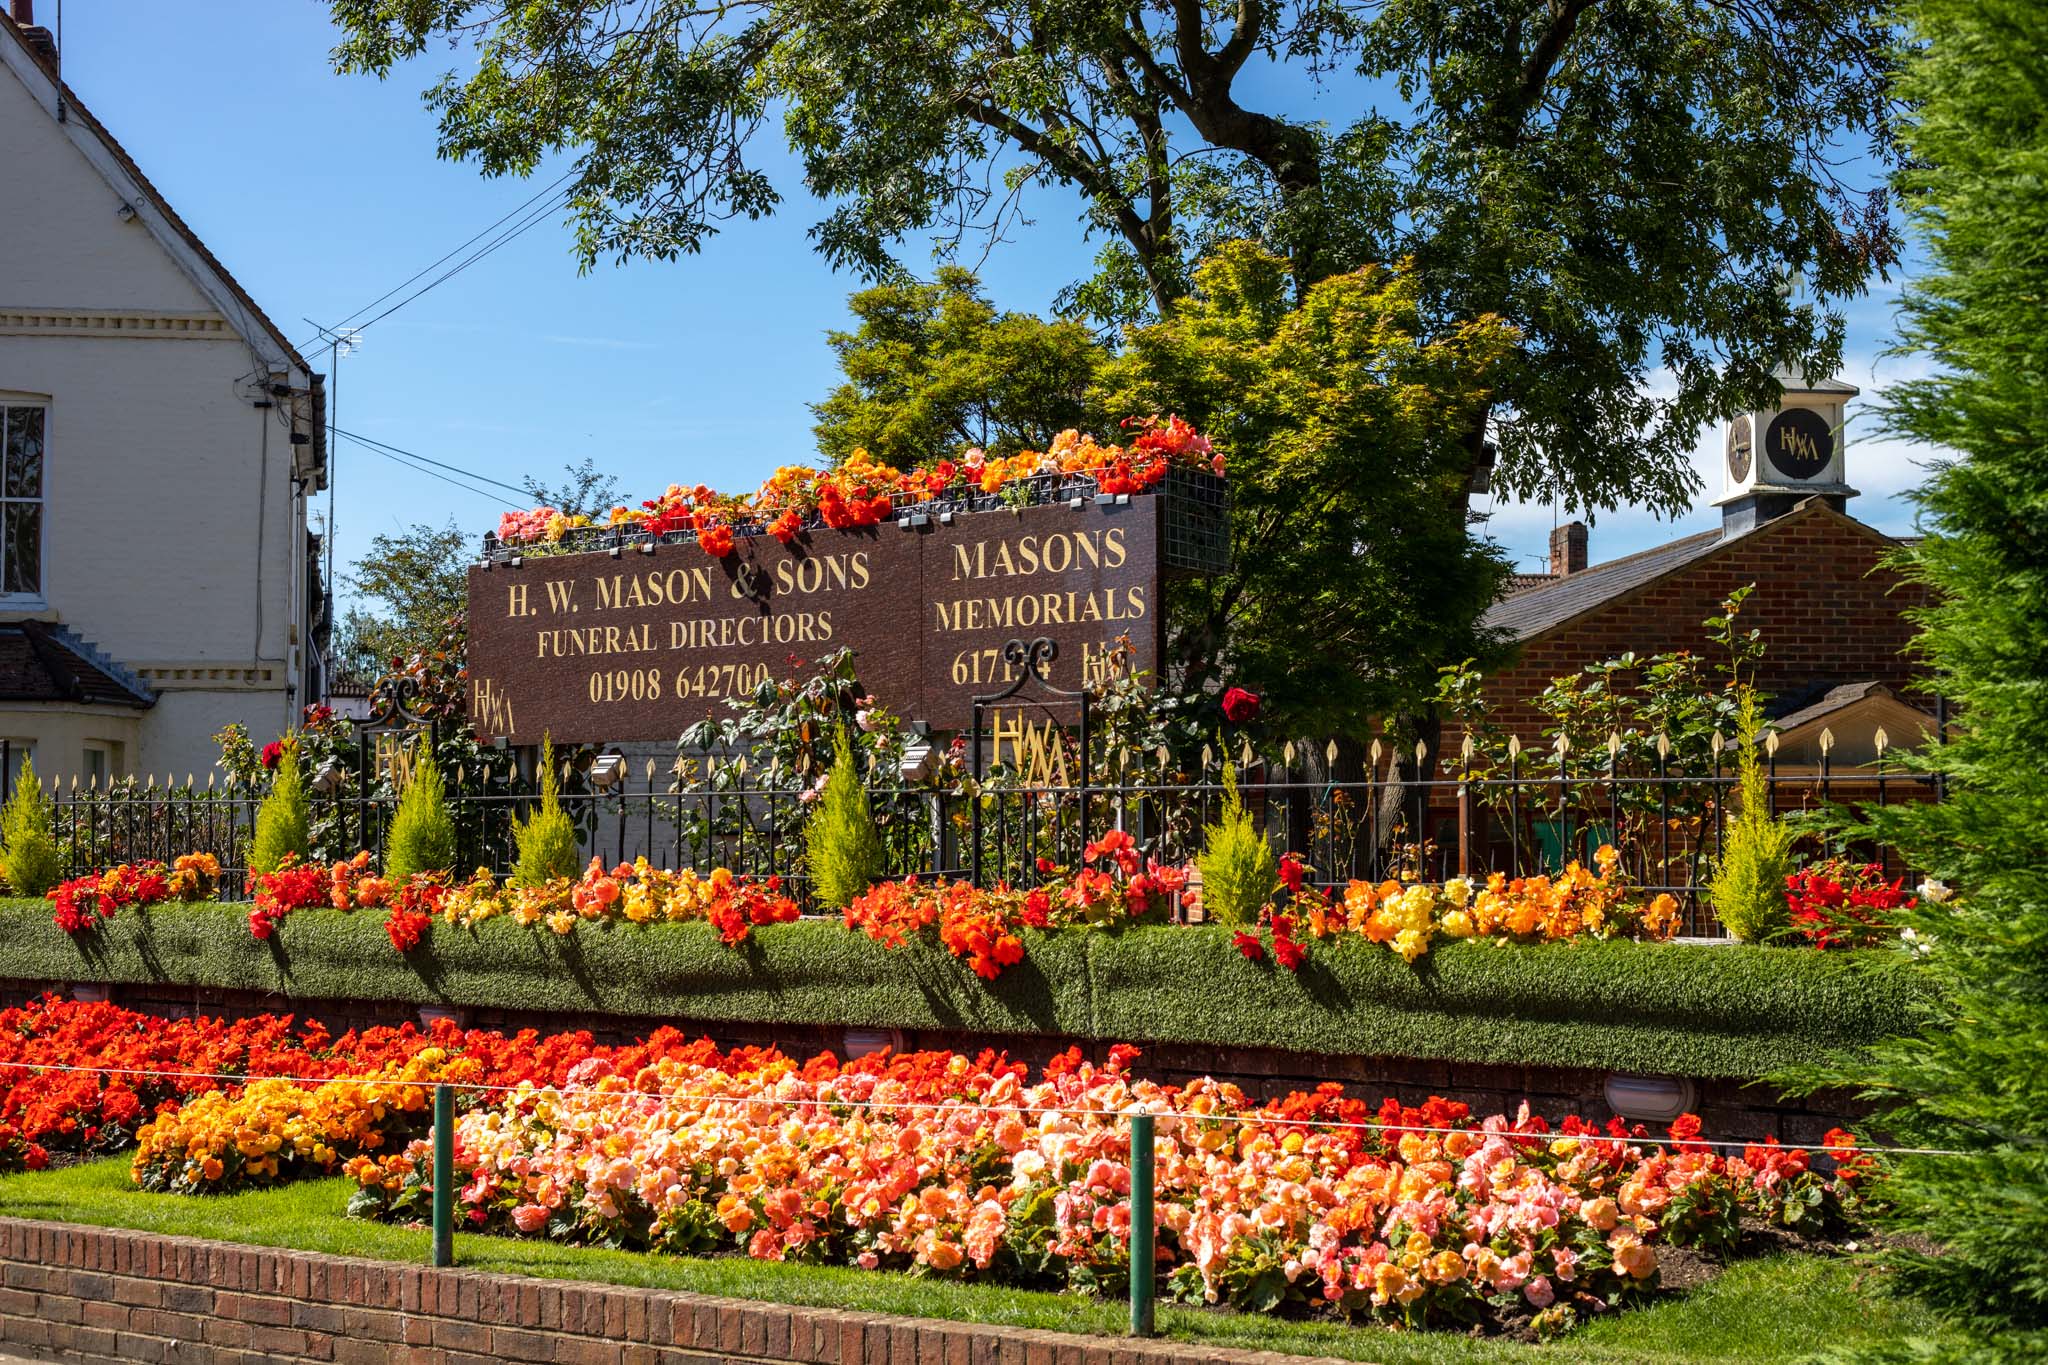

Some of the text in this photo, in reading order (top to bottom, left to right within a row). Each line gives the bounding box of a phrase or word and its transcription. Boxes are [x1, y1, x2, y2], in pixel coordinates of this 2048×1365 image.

[952, 527, 1127, 581] MASONS
[507, 552, 870, 617] H. W. MASON & SONS
[935, 586, 1145, 632] MEMORIALS
[537, 611, 832, 658] FUNERAL DIRECTORS
[589, 663, 769, 703] 01908 642700
[952, 645, 1052, 685] 61714
